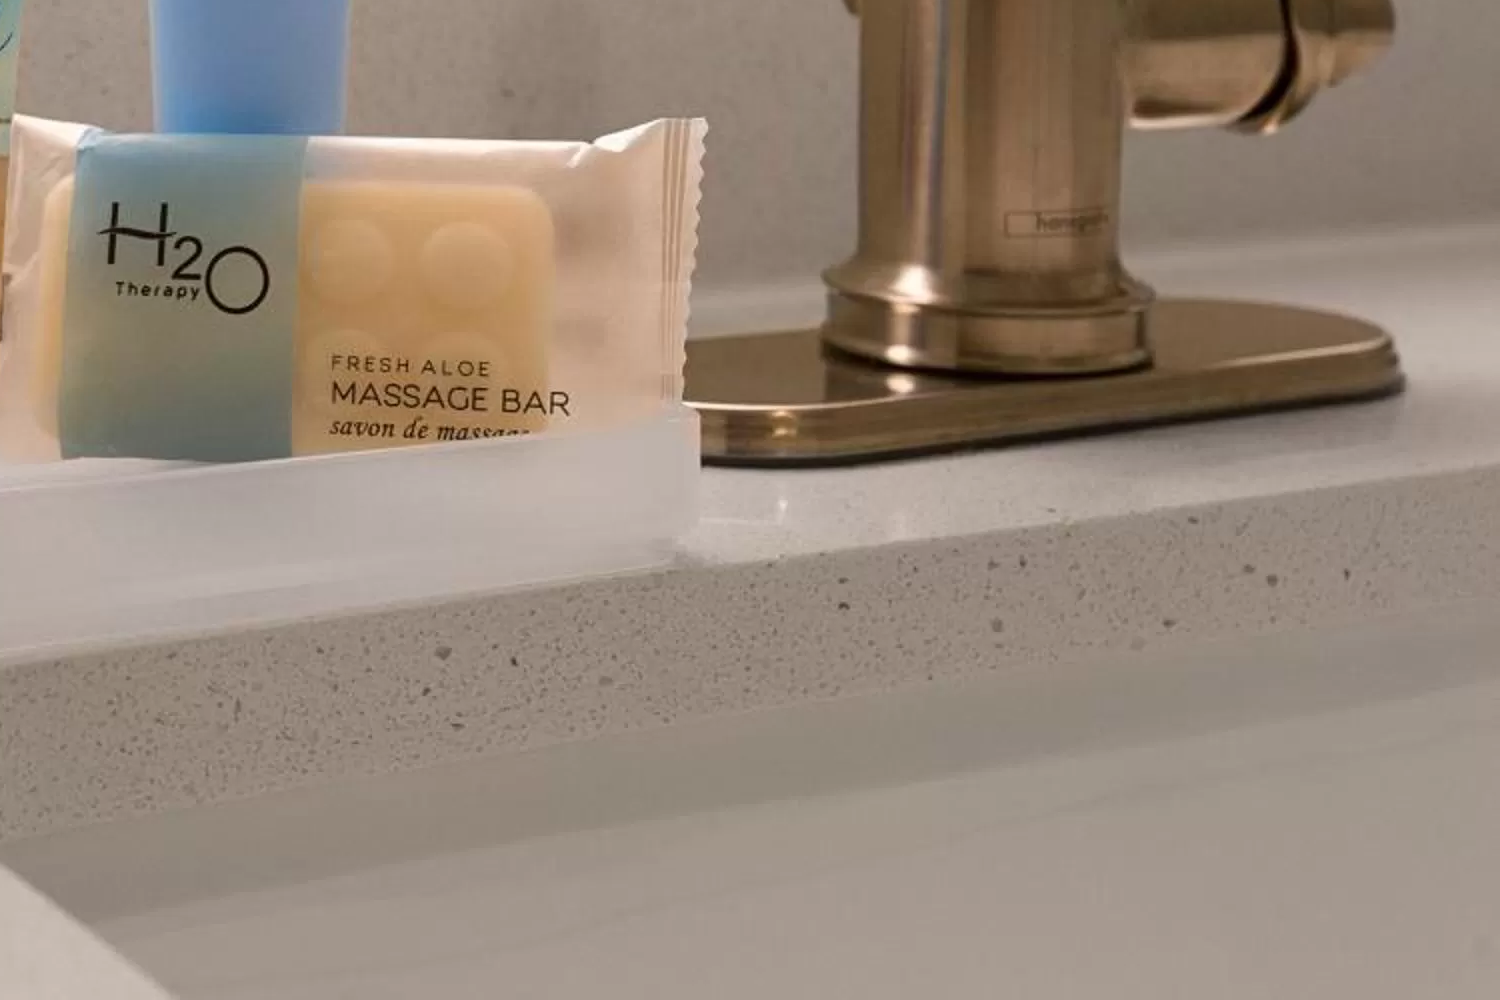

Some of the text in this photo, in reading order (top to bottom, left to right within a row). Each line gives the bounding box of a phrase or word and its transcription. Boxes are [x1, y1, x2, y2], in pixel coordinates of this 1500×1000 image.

[97, 201, 270, 315] H2O
[115, 281, 200, 301] Therapy
[331, 354, 491, 378] FRESH ALOE
[331, 380, 572, 417] MASSAGE BAR
[328, 419, 395, 438] savon
[403, 415, 430, 440] de
